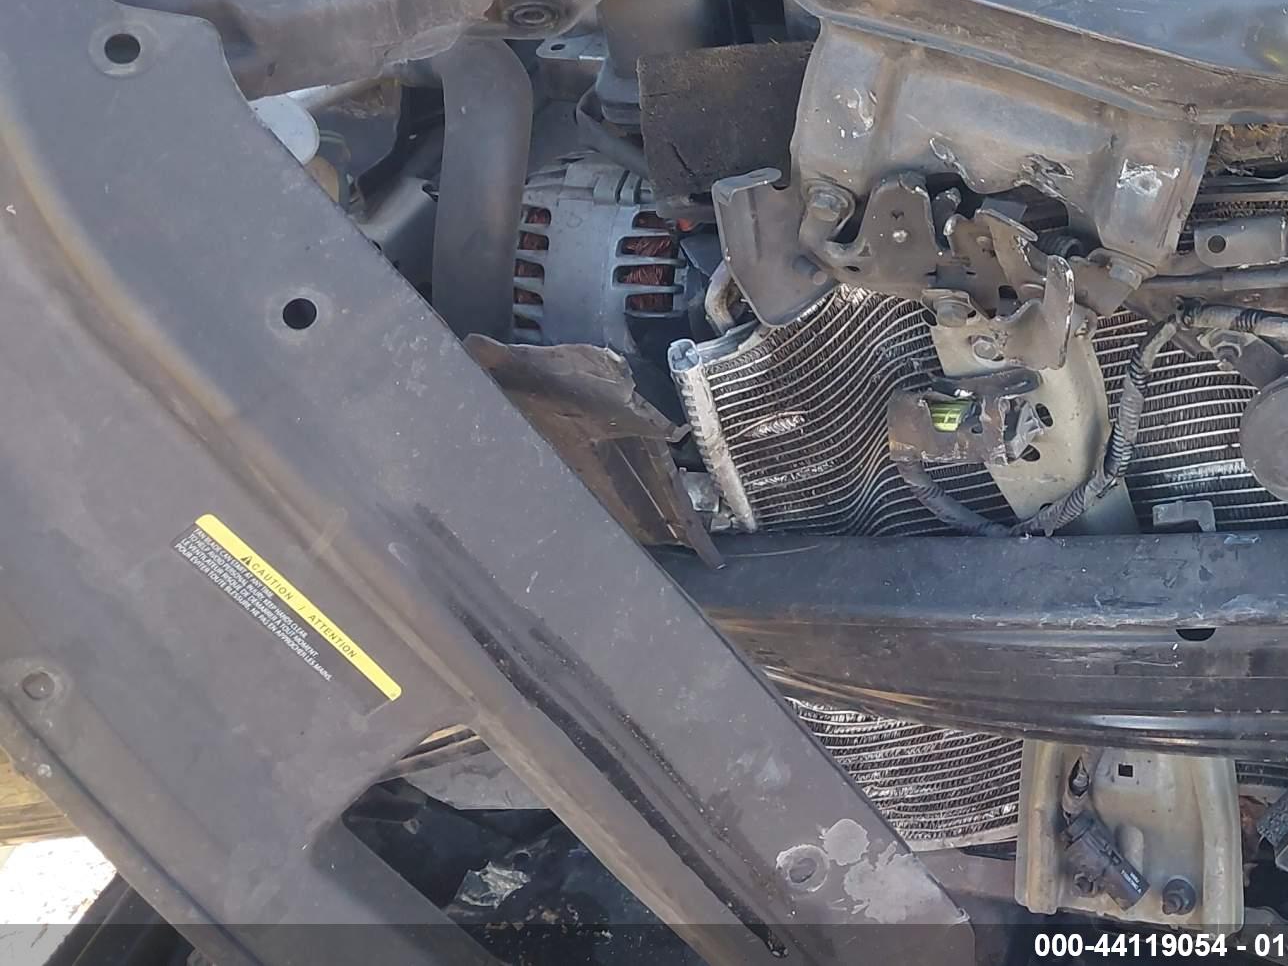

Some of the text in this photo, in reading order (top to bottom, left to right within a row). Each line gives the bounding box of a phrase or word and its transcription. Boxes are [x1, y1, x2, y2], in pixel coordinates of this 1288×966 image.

[180, 538, 191, 546] LE
[187, 543, 224, 575] VENTILATEUR
[220, 572, 243, 591] RISQUE
[239, 588, 250, 597] DE
[279, 623, 295, 637] TOUT
[188, 534, 198, 542] TO
[194, 539, 210, 552] HELP
[206, 550, 225, 565] AVOID
[221, 563, 248, 585] PERSONAL
[262, 598, 277, 611] KEEP
[274, 609, 293, 624] HANDS
[218, 550, 232, 561] CAN
[174, 543, 193, 558] POUR
[206, 571, 226, 588] TOUTE
[249, 608, 260, 617] NE
[256, 615, 270, 625] PAS
[273, 629, 307, 658] APPROCHER
[303, 655, 315, 665] LES
[250, 563, 293, 600] CAUTION
[308, 615, 357, 657] ATTENTION
